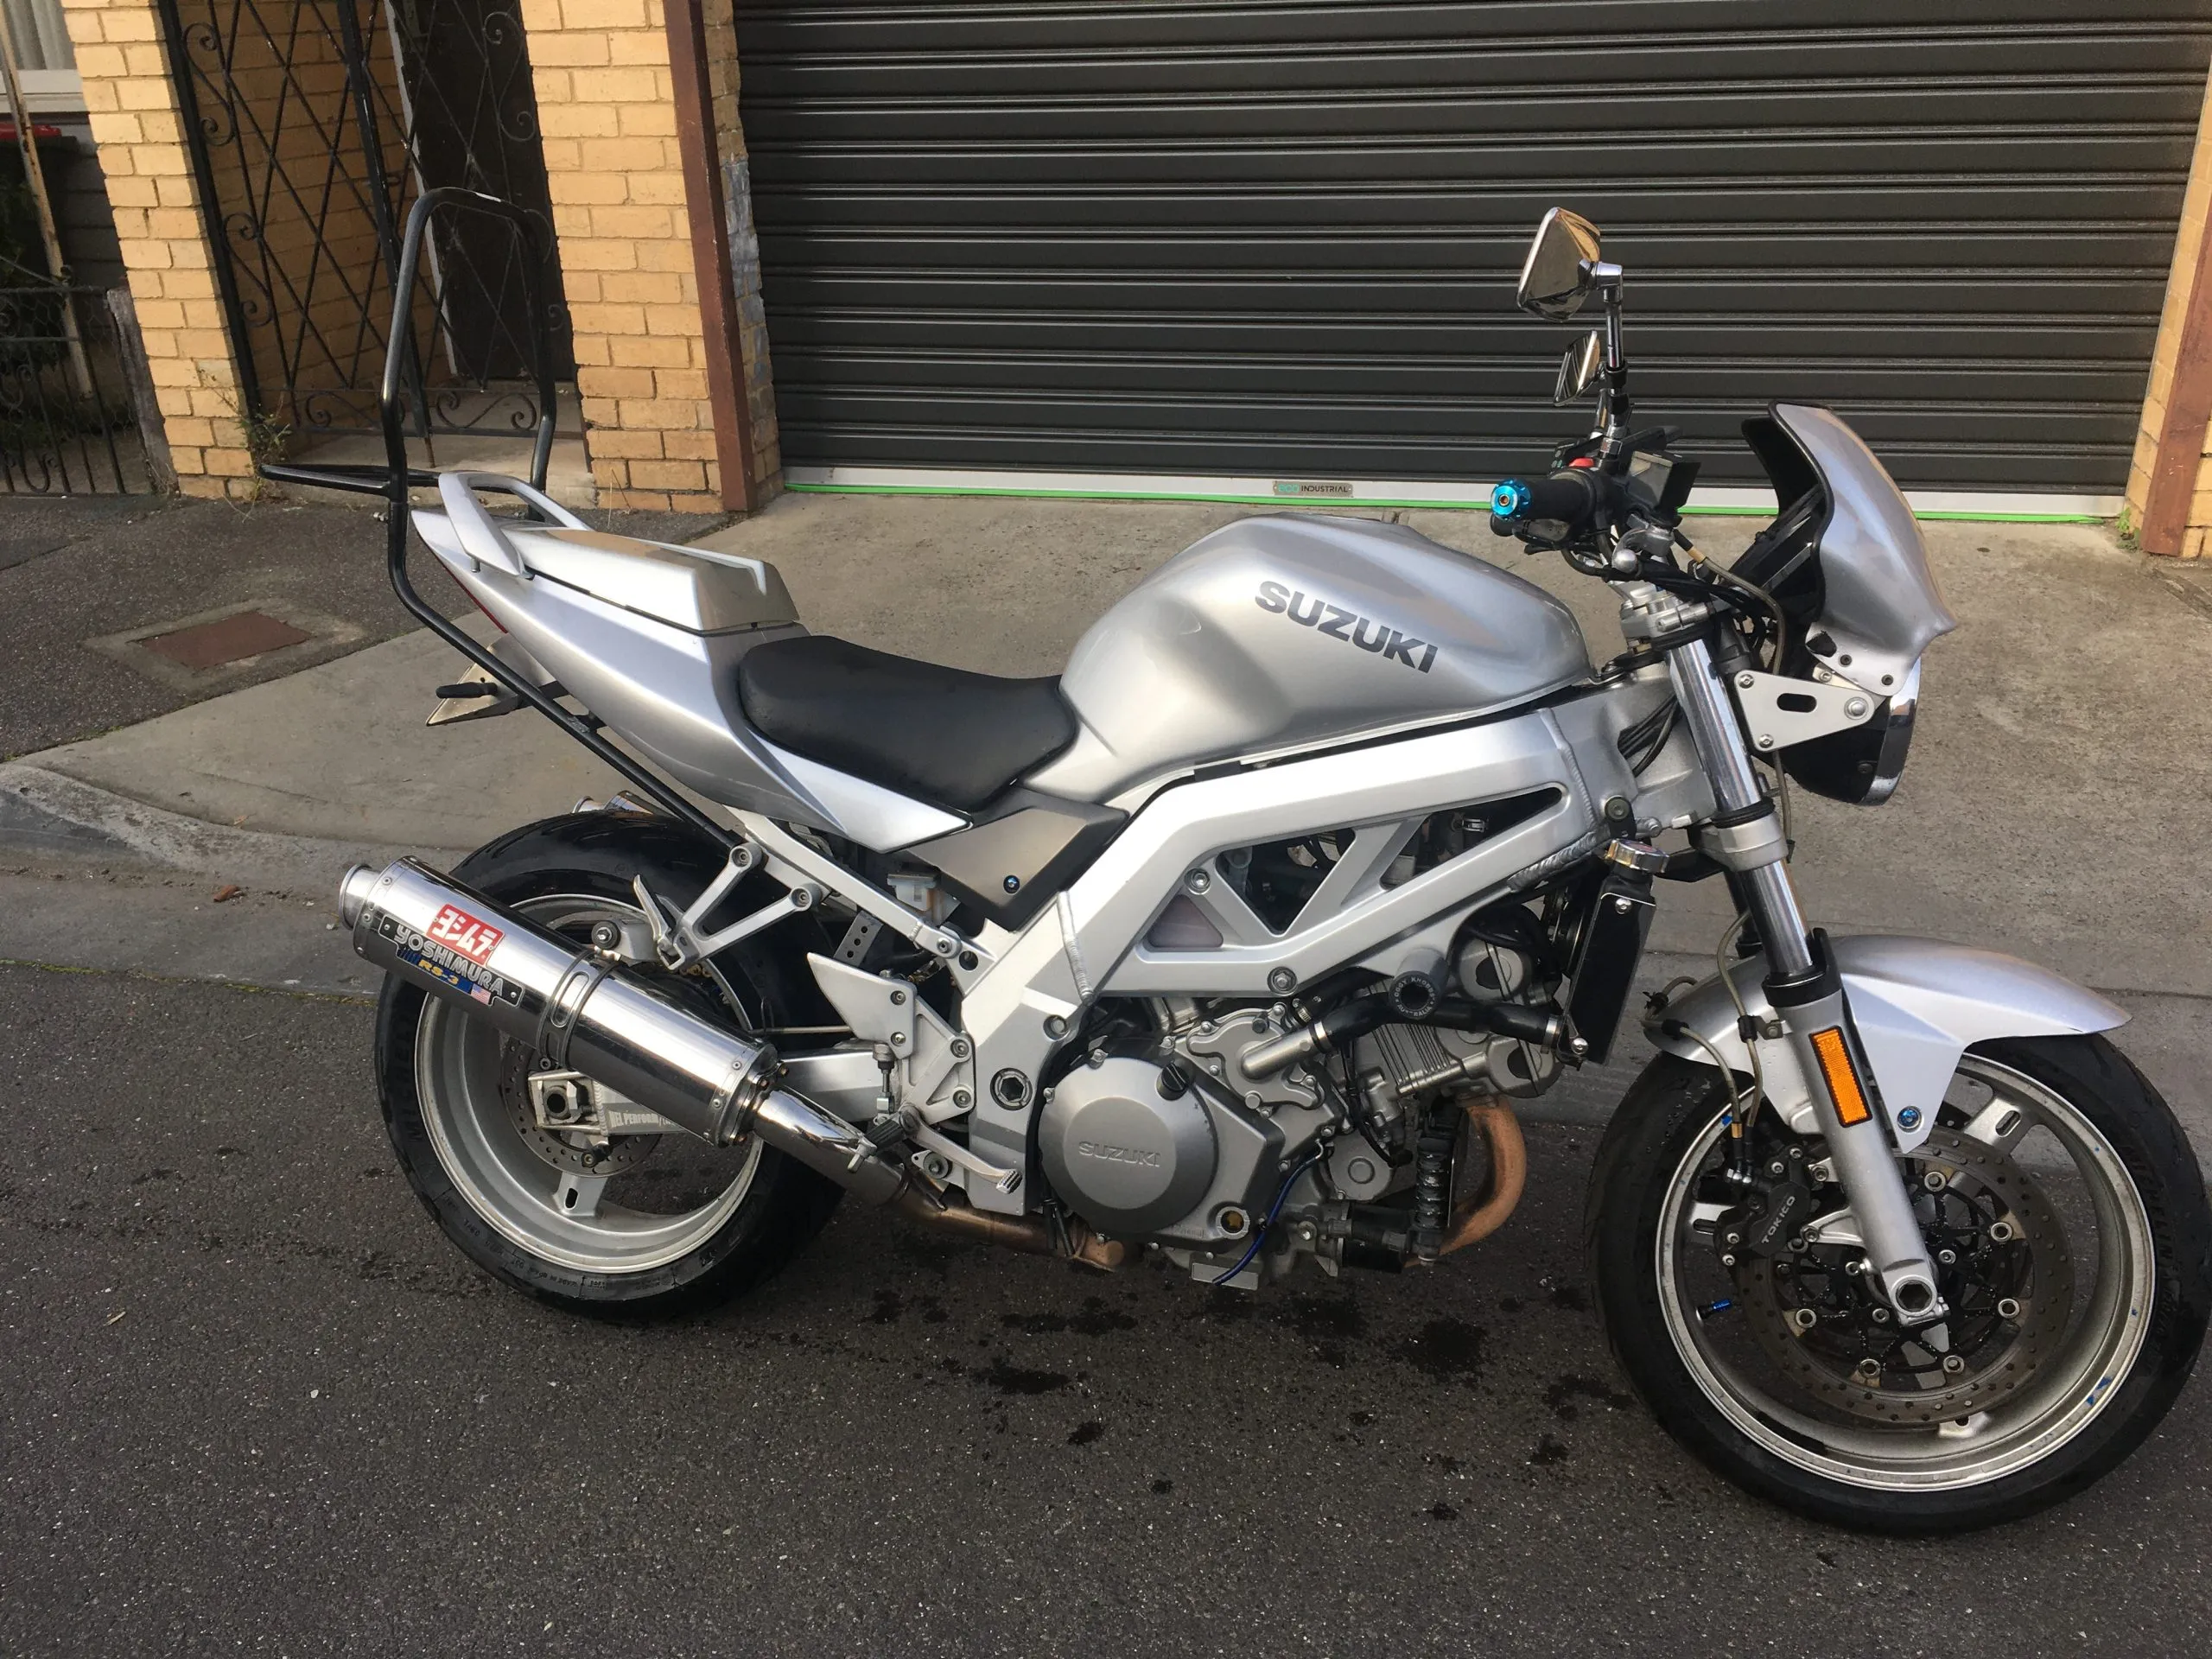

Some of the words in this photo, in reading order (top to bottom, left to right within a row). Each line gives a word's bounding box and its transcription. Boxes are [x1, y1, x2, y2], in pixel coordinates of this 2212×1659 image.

[1301, 485, 1349, 493] INDUSTRIAL
[1255, 580, 1439, 674] SUZUKI
[431, 908, 498, 957] ヨシムラ
[393, 924, 505, 996] YOSHIMURA
[417, 959, 460, 985] RS-3
[1396, 1003, 1433, 1017] AURALIA
[395, 997, 424, 1141] MICHELI
[1078, 1141, 1161, 1167] SUZUKI
[1761, 1196, 1796, 1244] TOKICO
